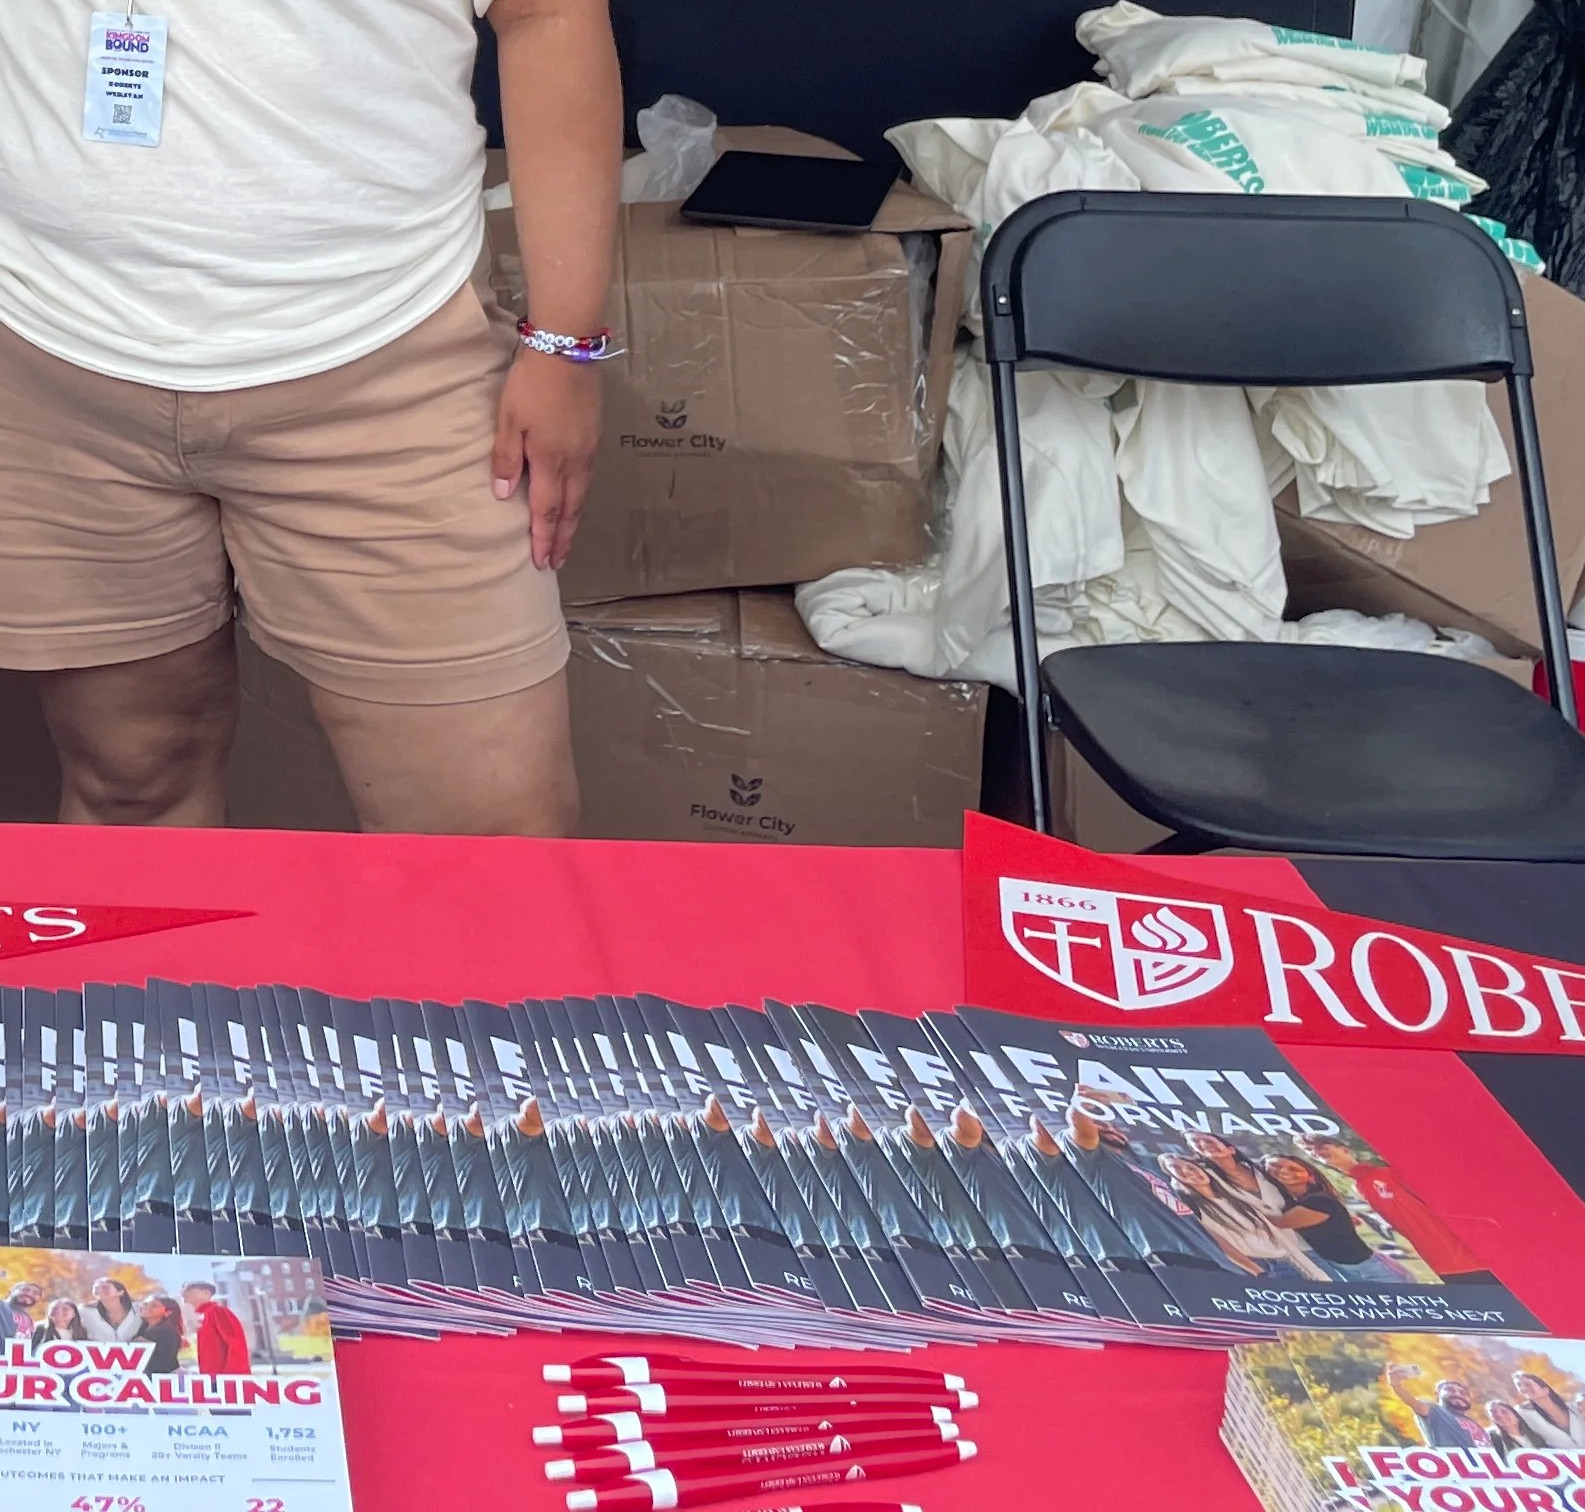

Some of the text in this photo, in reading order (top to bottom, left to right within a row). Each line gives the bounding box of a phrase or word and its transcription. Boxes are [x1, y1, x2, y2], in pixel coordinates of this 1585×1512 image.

[106, 39, 150, 53] BOUND
[101, 66, 150, 79] SPONSOR
[1174, 109, 1265, 194] OBERTS
[620, 434, 727, 452] Flower City
[690, 804, 753, 826] Flower
[759, 816, 796, 836] City
[1022, 891, 1098, 912] 1866
[1243, 908, 1585, 1042] ROBE
[1088, 1033, 1185, 1049] ROBERTS
[1001, 1044, 1318, 1111] FAITH
[1042, 1090, 1341, 1138] FORWARD
[1245, 1287, 1449, 1309] ROOTED IN FAITH
[1211, 1296, 1506, 1323] READY FOR WHAT'S NEXT
[77, 1374, 323, 1406] CALLING
[12, 1420, 42, 1433] NY
[81, 1422, 128, 1436] 100+
[167, 1424, 229, 1437] NCAA
[265, 1426, 317, 1441] 1,752
[45, 1447, 61, 1457] NY
[69, 1471, 105, 1482] THAT
[108, 1472, 147, 1483] MAKE
[150, 1474, 170, 1483] AN
[174, 1474, 226, 1484] IMPACT
[70, 1494, 146, 1512] 47%
[245, 1496, 286, 1512] 22
[1388, 1484, 1562, 1512] YOUR
